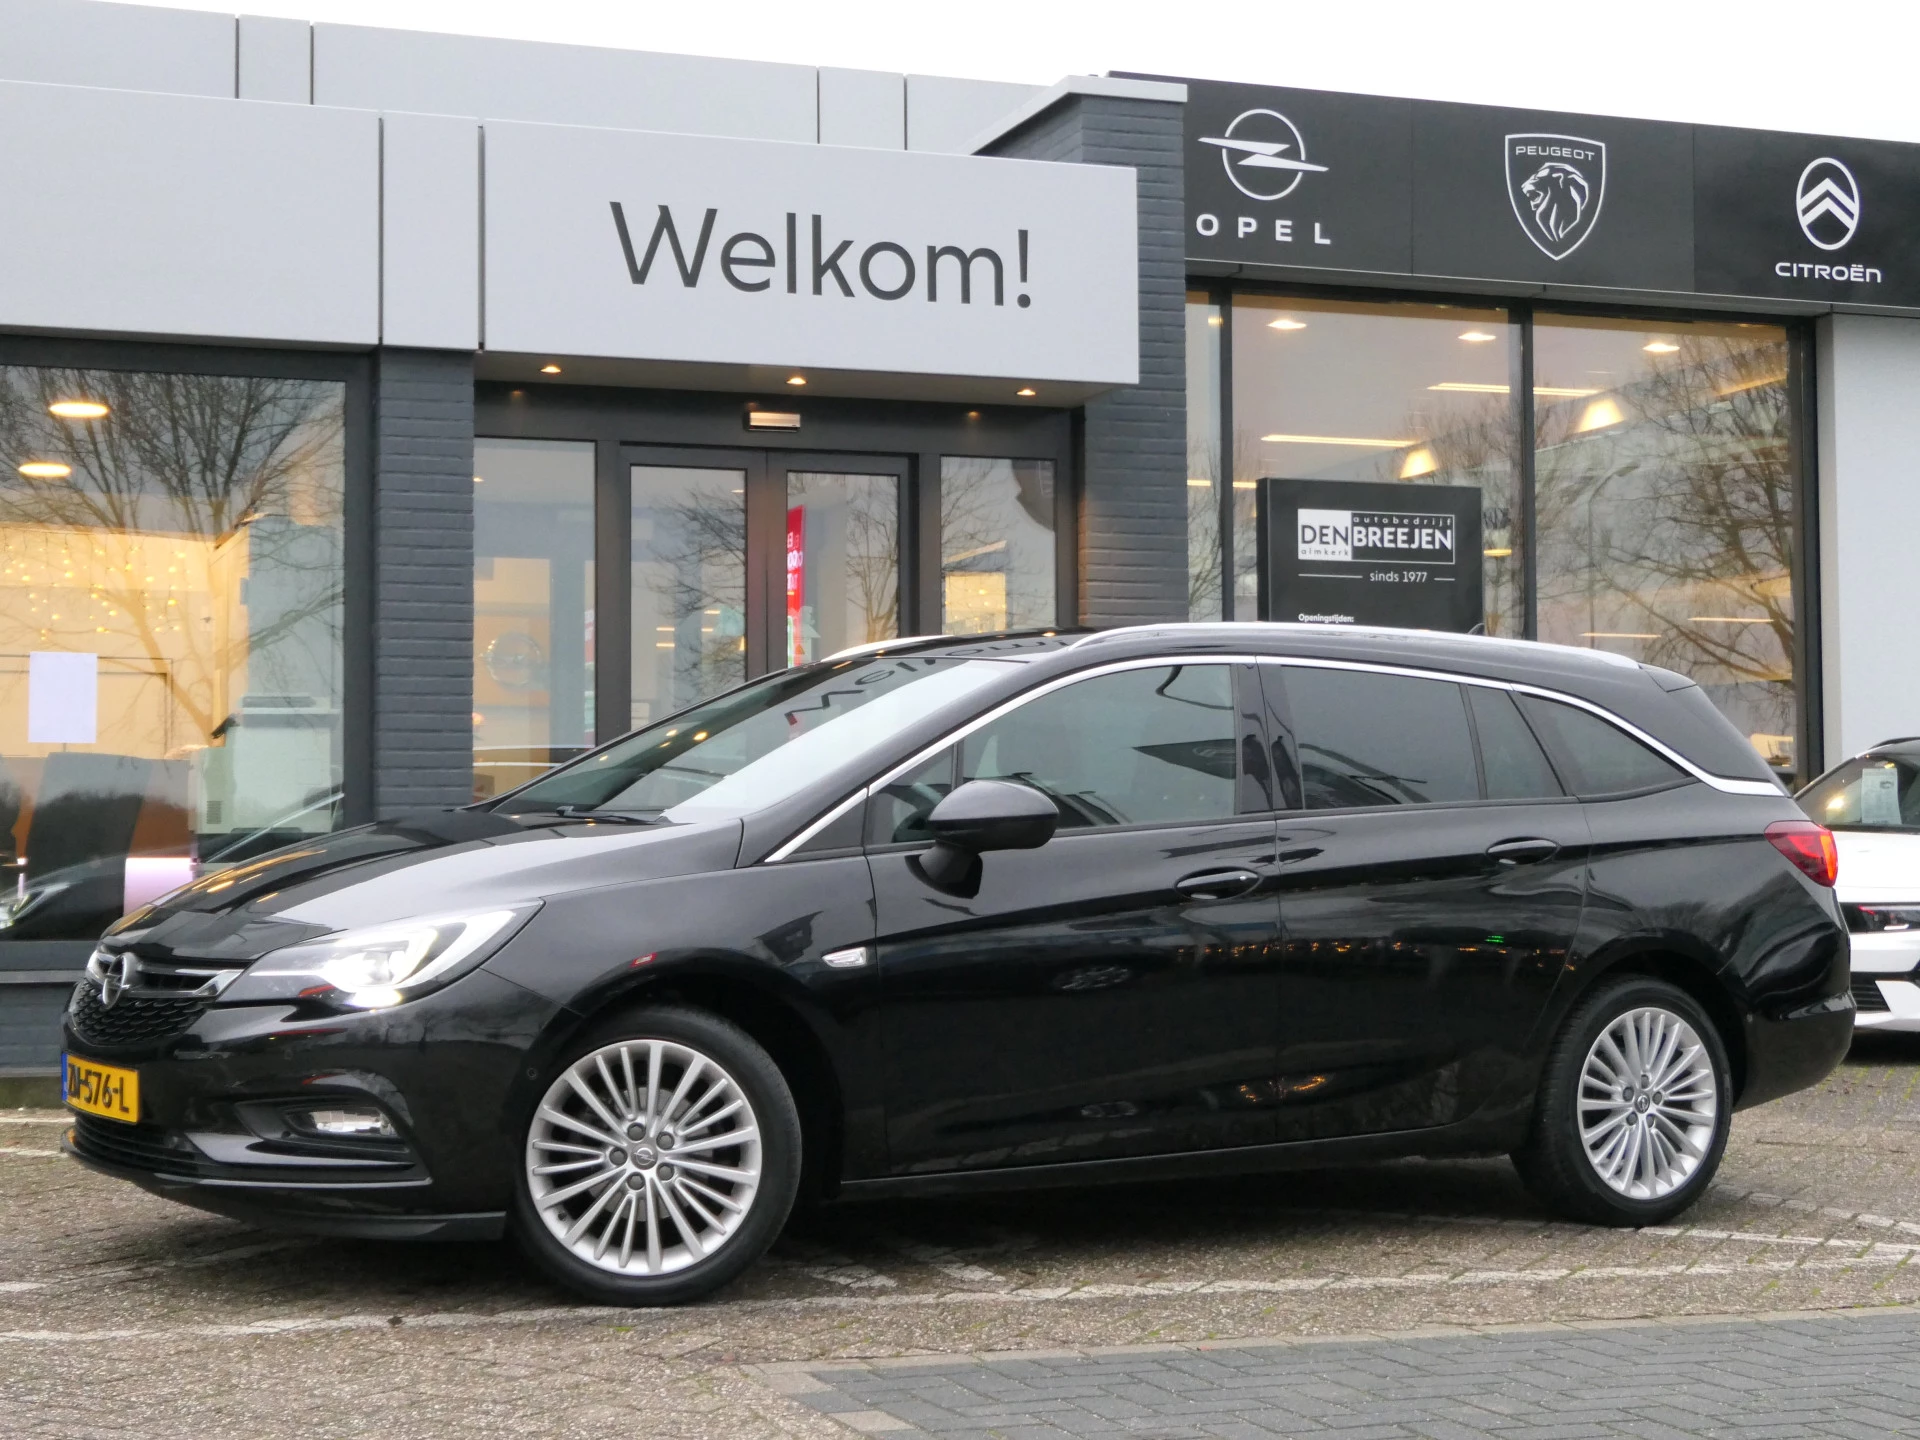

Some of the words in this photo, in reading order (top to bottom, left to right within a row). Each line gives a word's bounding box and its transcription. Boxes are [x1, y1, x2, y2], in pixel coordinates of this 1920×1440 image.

[1516, 146, 1595, 161] PEUGEOT
[1196, 213, 1332, 245] OPEL
[609, 201, 1031, 309] Welkom!
[1353, 515, 1452, 527] autobedrijf
[1301, 524, 1349, 547] DEN
[1353, 526, 1452, 550] BREEJEN
[1369, 571, 1400, 582] sinds
[1402, 571, 1428, 583] 1977
